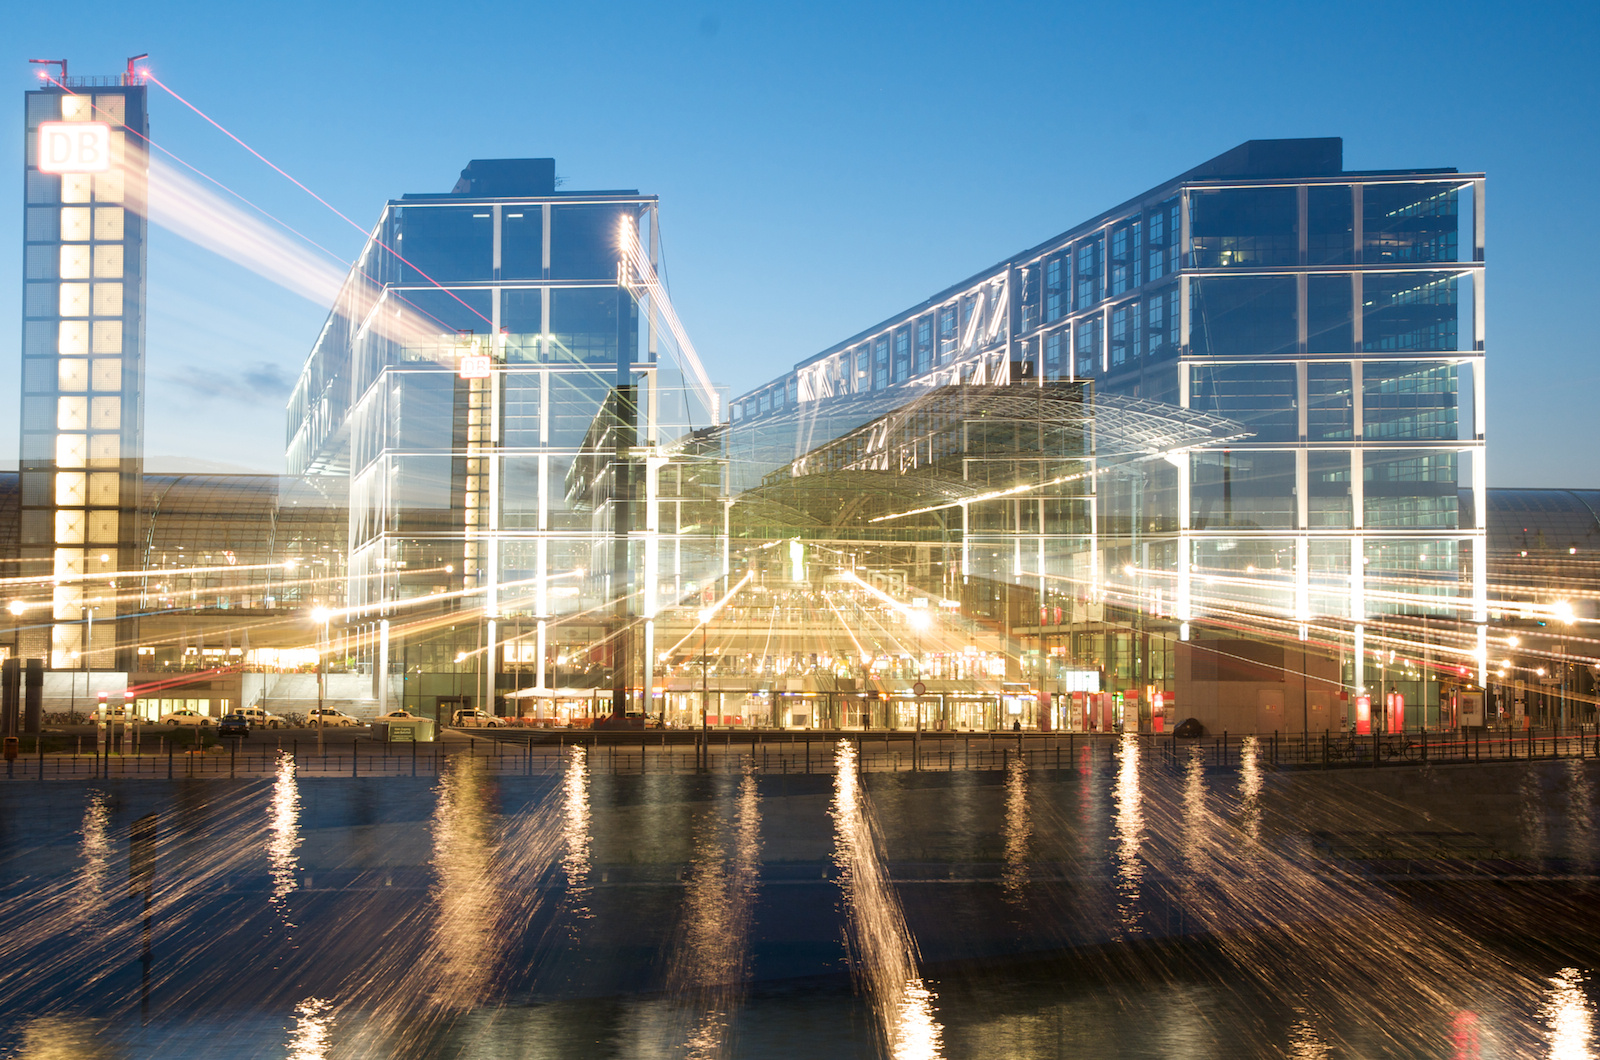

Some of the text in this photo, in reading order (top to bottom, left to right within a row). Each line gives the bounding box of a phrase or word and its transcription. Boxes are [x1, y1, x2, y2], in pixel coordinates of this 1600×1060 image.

[49, 132, 99, 164] DB
[465, 360, 486, 374] DB
[872, 574, 902, 594] DB
